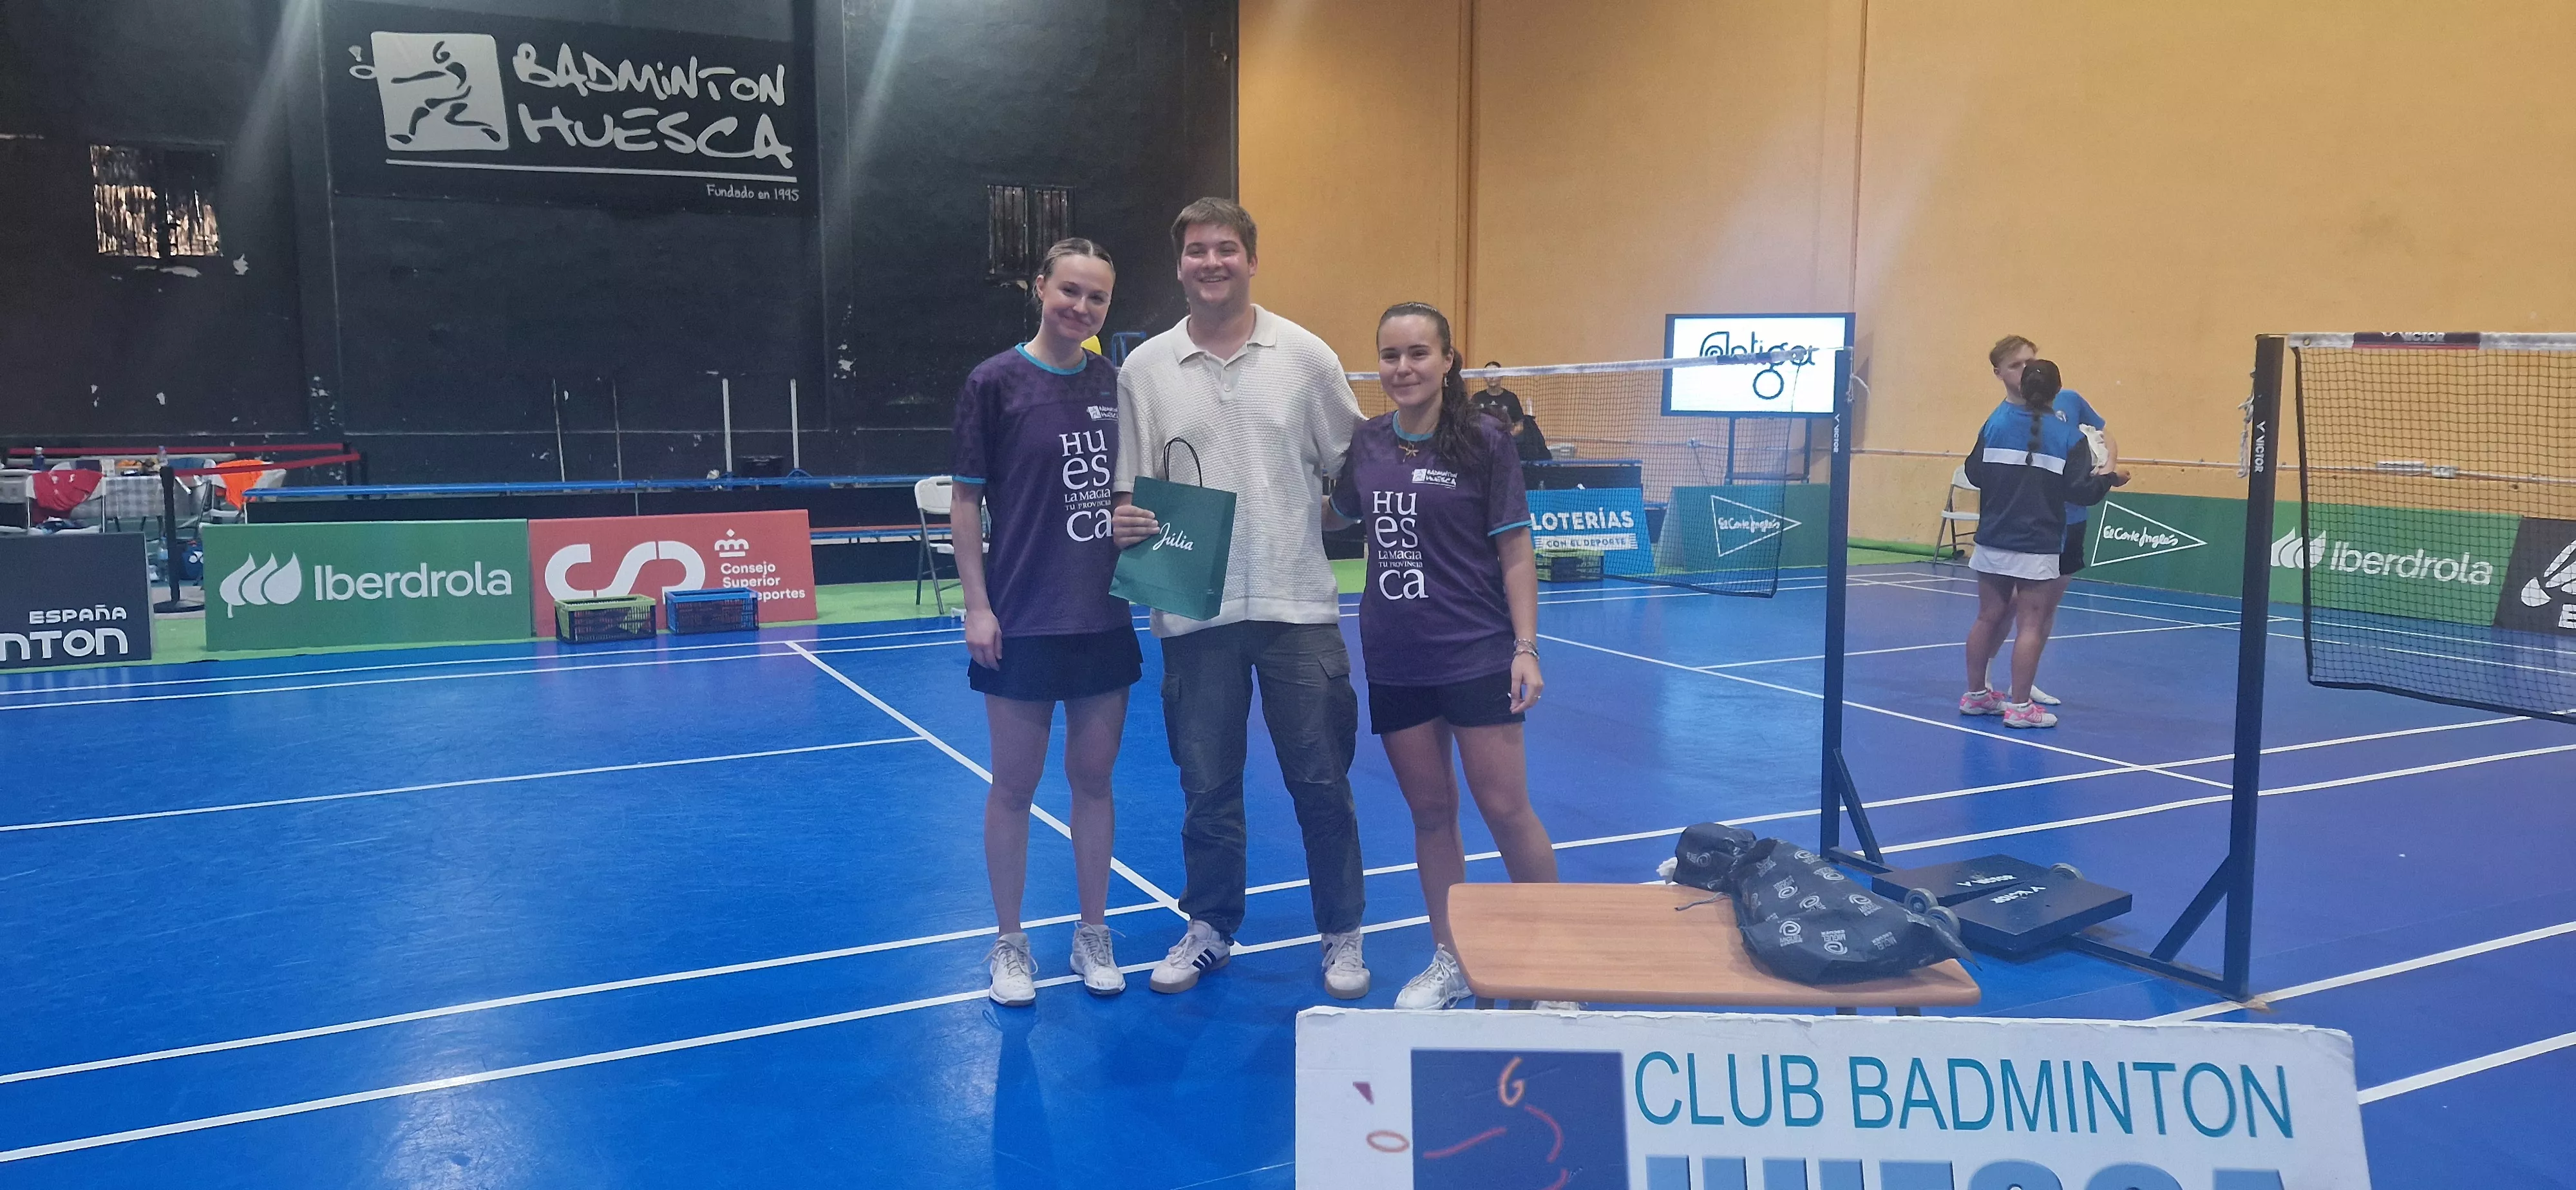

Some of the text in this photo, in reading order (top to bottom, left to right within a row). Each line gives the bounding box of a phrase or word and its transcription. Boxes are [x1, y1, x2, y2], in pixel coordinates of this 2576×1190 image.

[518, 103, 793, 169] HUESCA
[706, 184, 799, 201] Fundado en 1995
[2255, 435, 2265, 473] VICTOR
[1530, 507, 1634, 531] LOTERÍAS
[1584, 538, 1627, 547] DEPORTE
[2114, 527, 2140, 542] Corte
[2139, 526, 2179, 549] Inglés
[721, 561, 776, 575] Consejo
[2330, 541, 2493, 585] Iberdrola
[314, 561, 512, 601] Iberdrola
[723, 574, 781, 588] Superior
[757, 588, 806, 603] eportes
[29, 604, 127, 625] ESPAÑA
[1635, 1051, 2293, 1138] CLUB BADMINTON
